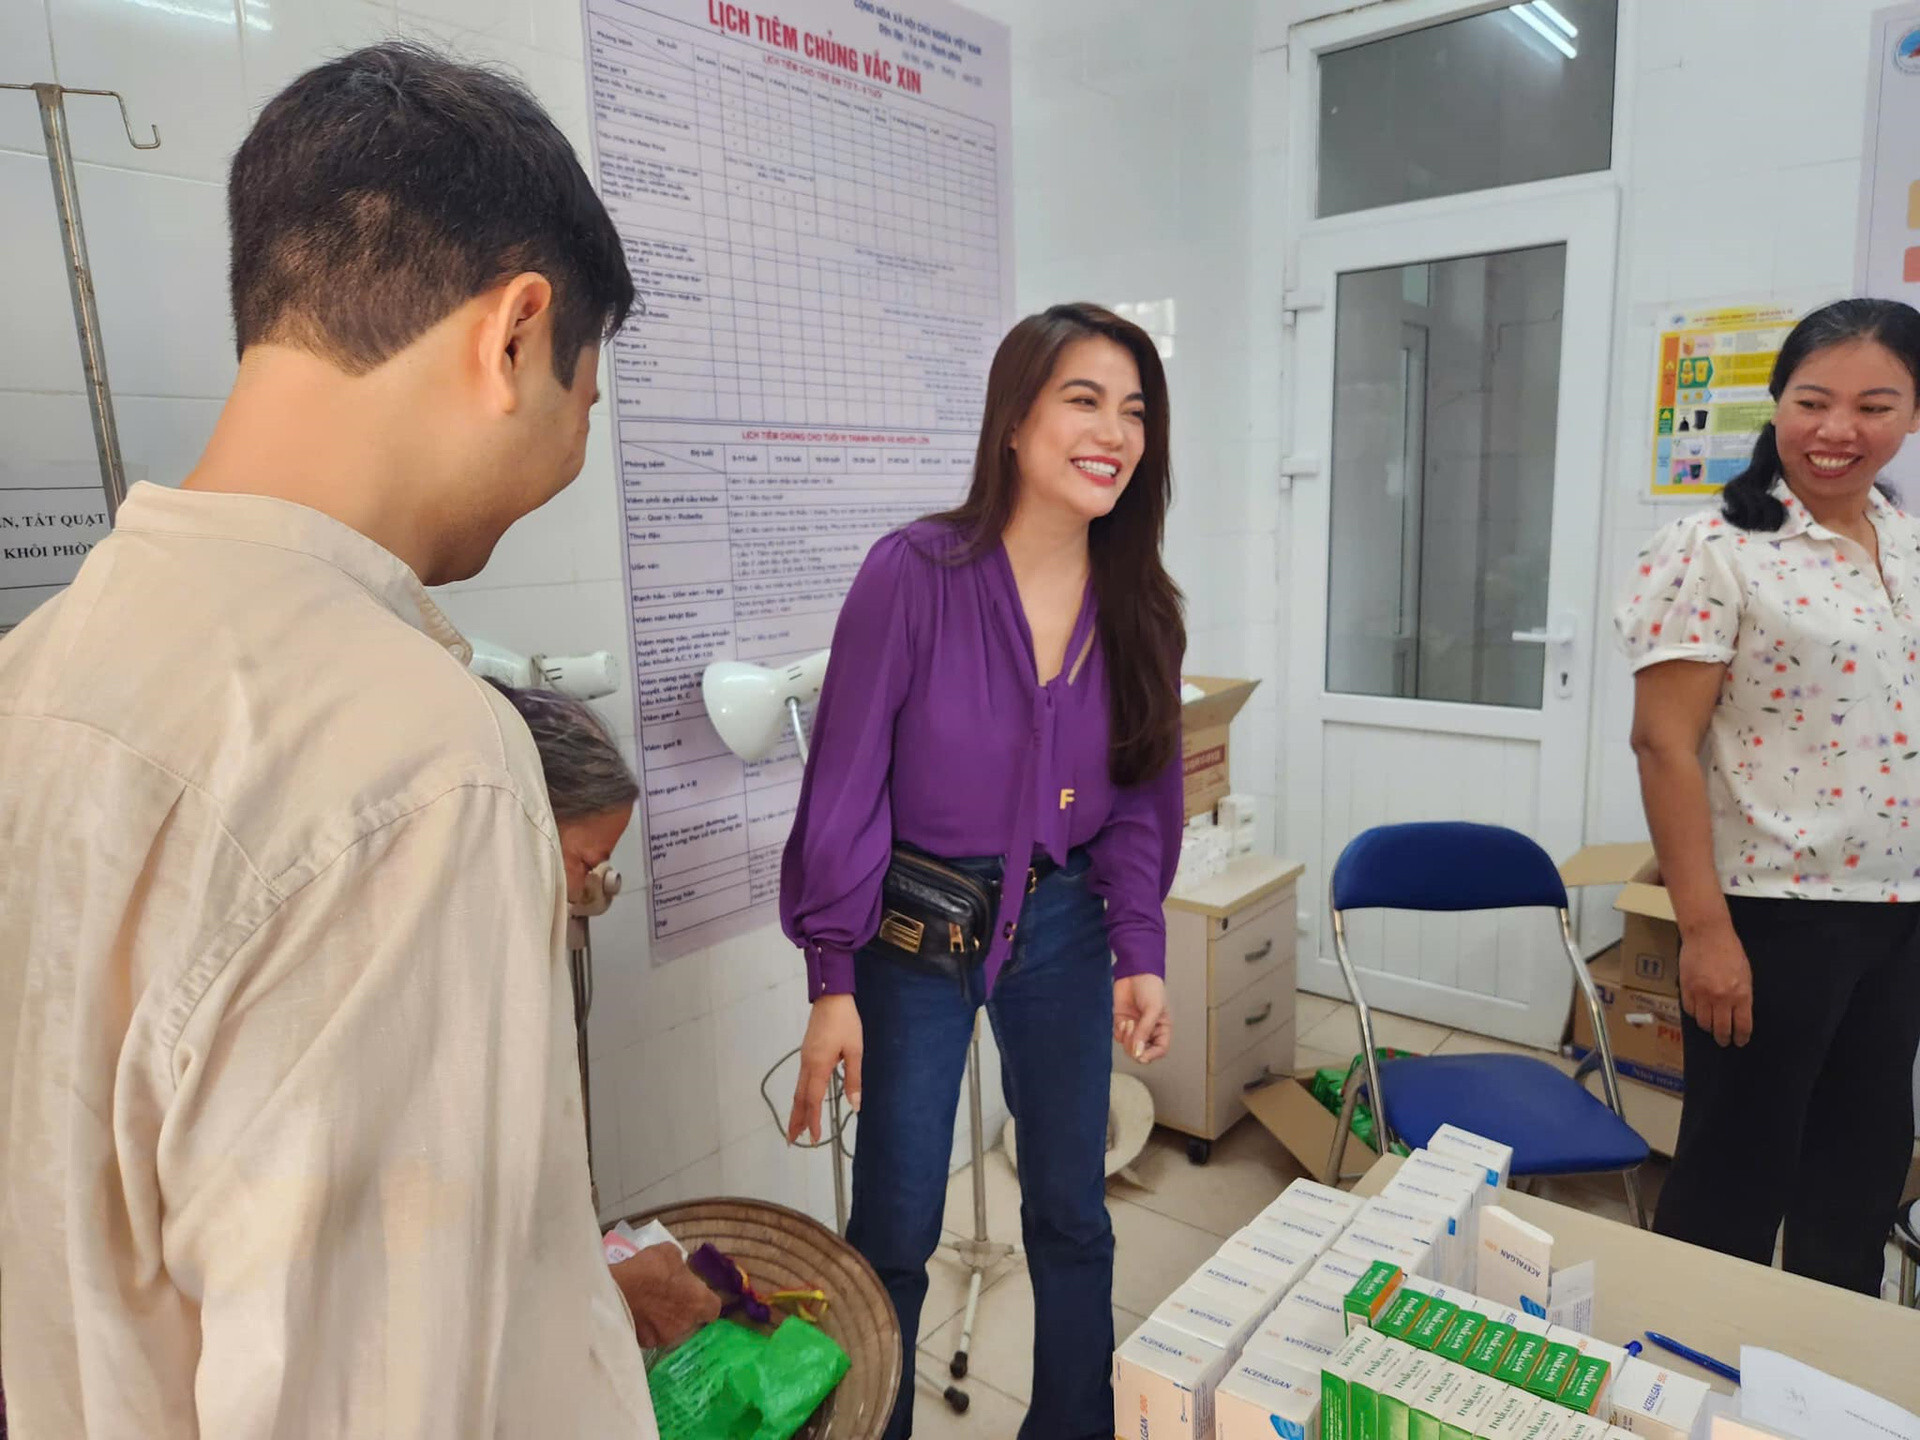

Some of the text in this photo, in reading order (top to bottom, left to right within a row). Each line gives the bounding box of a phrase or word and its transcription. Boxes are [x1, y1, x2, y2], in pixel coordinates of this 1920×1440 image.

[708, 0, 750, 36] LỊCH
[755, 14, 798, 54] TIÊM
[804, 30, 858, 73] CHỦNG
[896, 65, 921, 94] XIN
[61, 512, 106, 528] QUẠT
[1059, 788, 1075, 810] F
[1501, 1248, 1541, 1278] ACEFALGAN
[1140, 1335, 1183, 1357] ACEFALGAN
[1284, 1335, 1334, 1357] ACEFALGAN
[1242, 1366, 1292, 1390] ACEFALGAN
